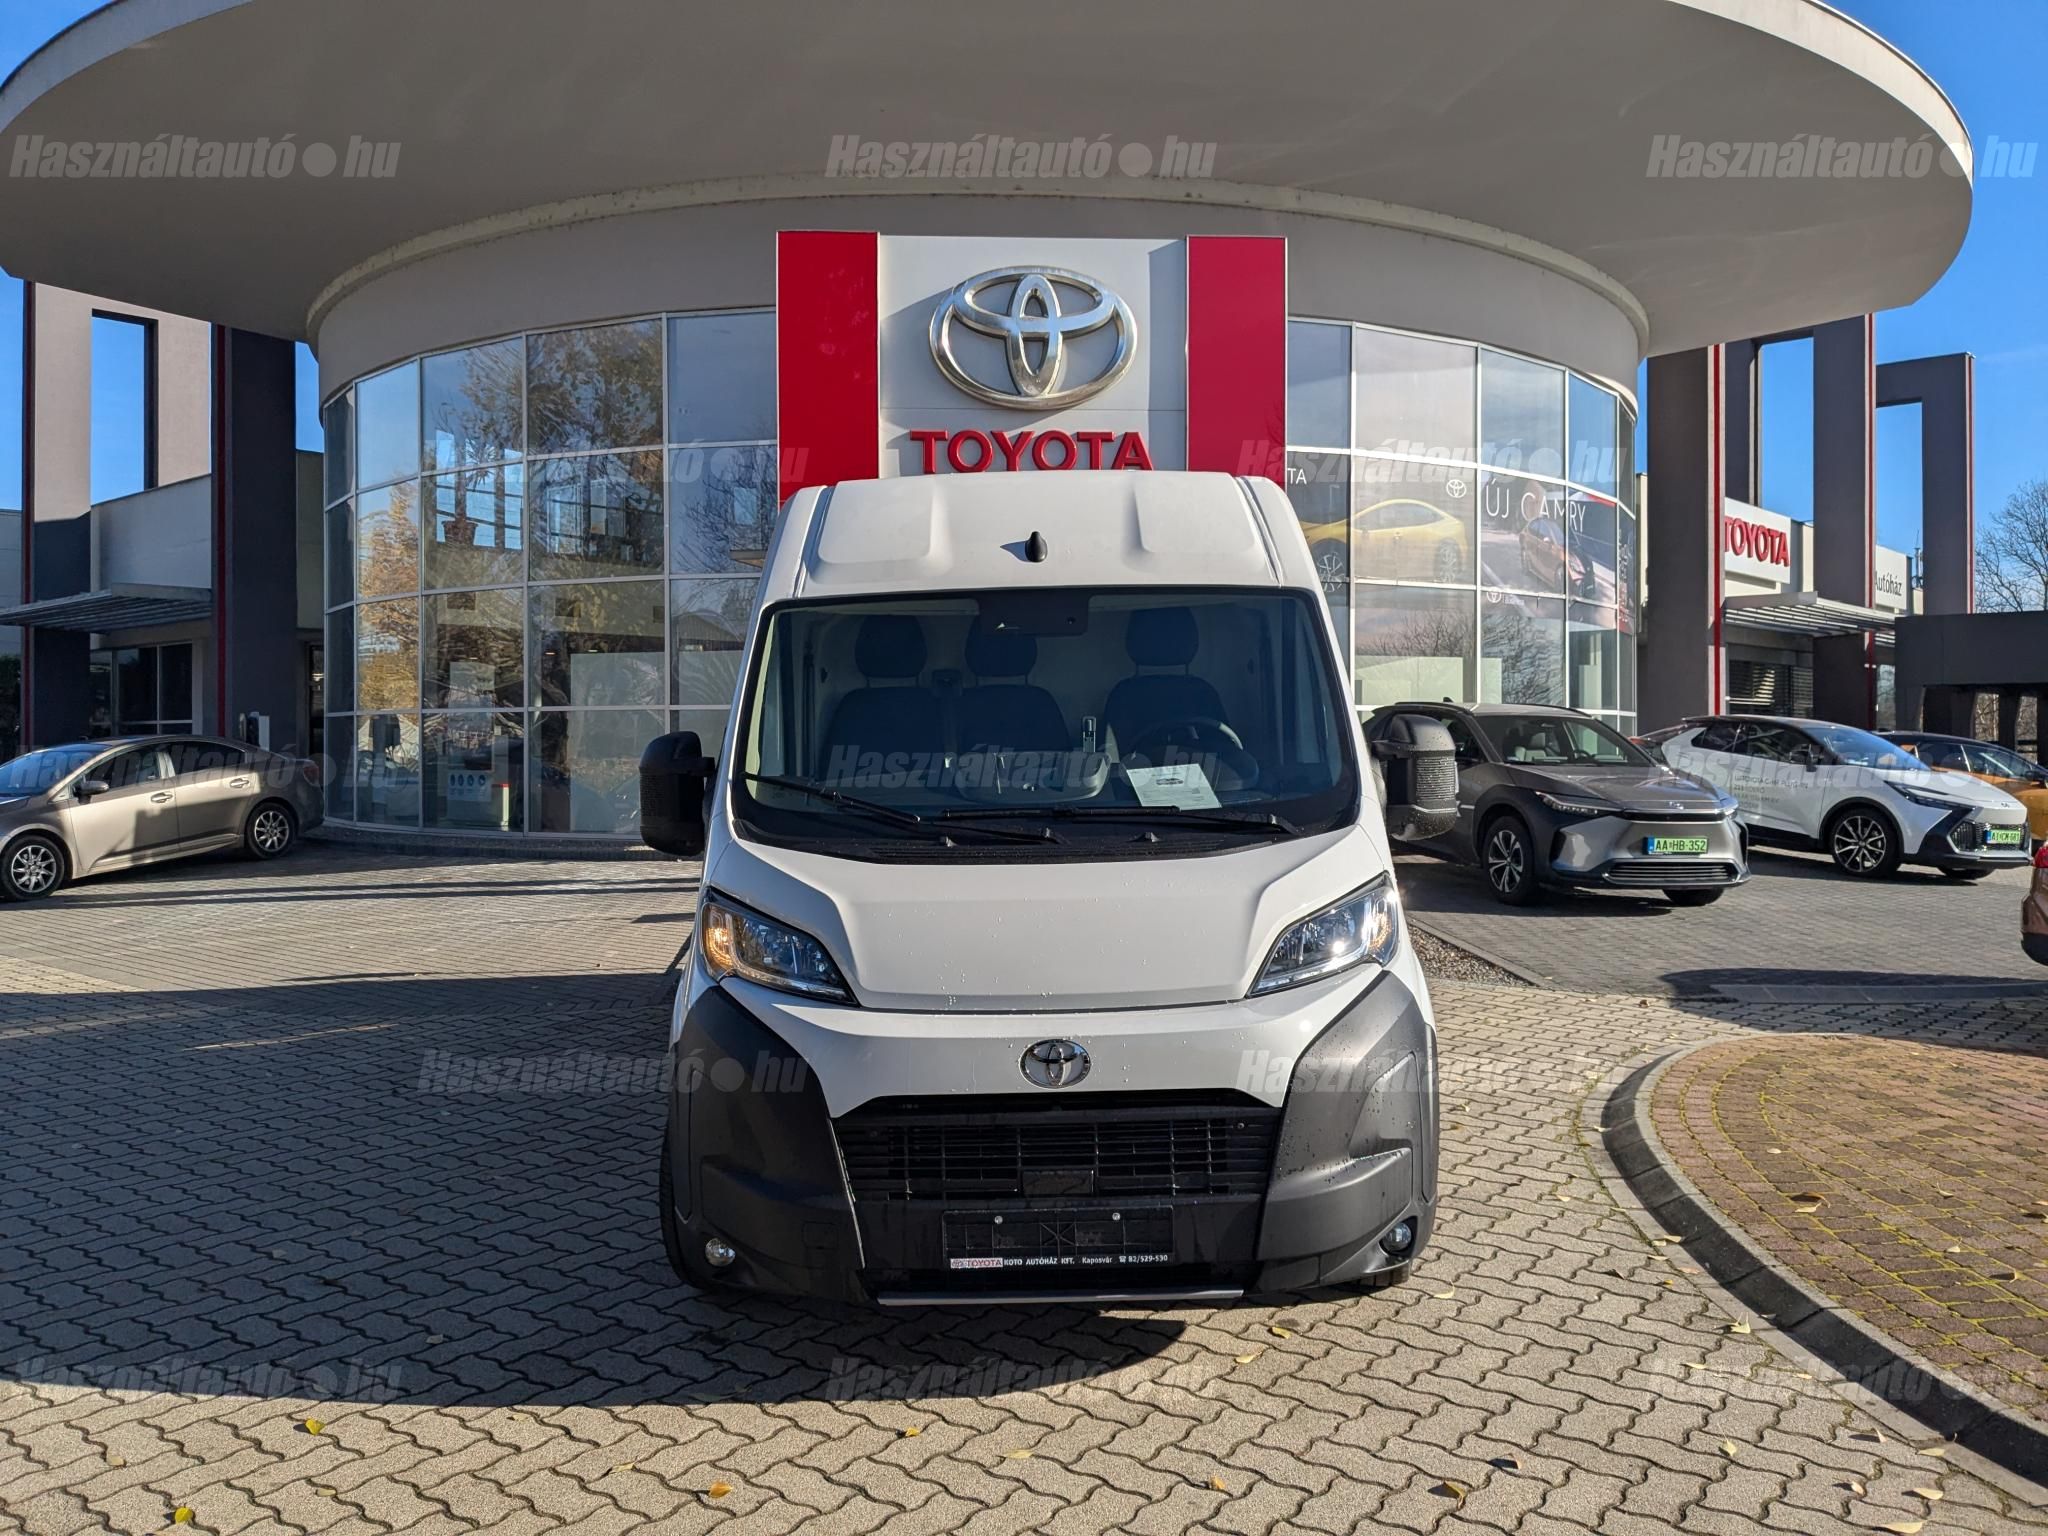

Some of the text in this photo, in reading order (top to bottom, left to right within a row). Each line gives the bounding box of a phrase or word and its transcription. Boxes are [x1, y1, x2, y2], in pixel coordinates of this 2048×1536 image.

[910, 430, 1153, 474] TOYOTA
[1486, 478, 1586, 534] ÚJ CAMRY
[1724, 516, 1790, 567] TOYOTA
[967, 1259, 1002, 1267] TOYOTA
[1025, 1256, 1058, 1266] AUTÓHÁZ
[1082, 1256, 1113, 1265] Kaposvár
